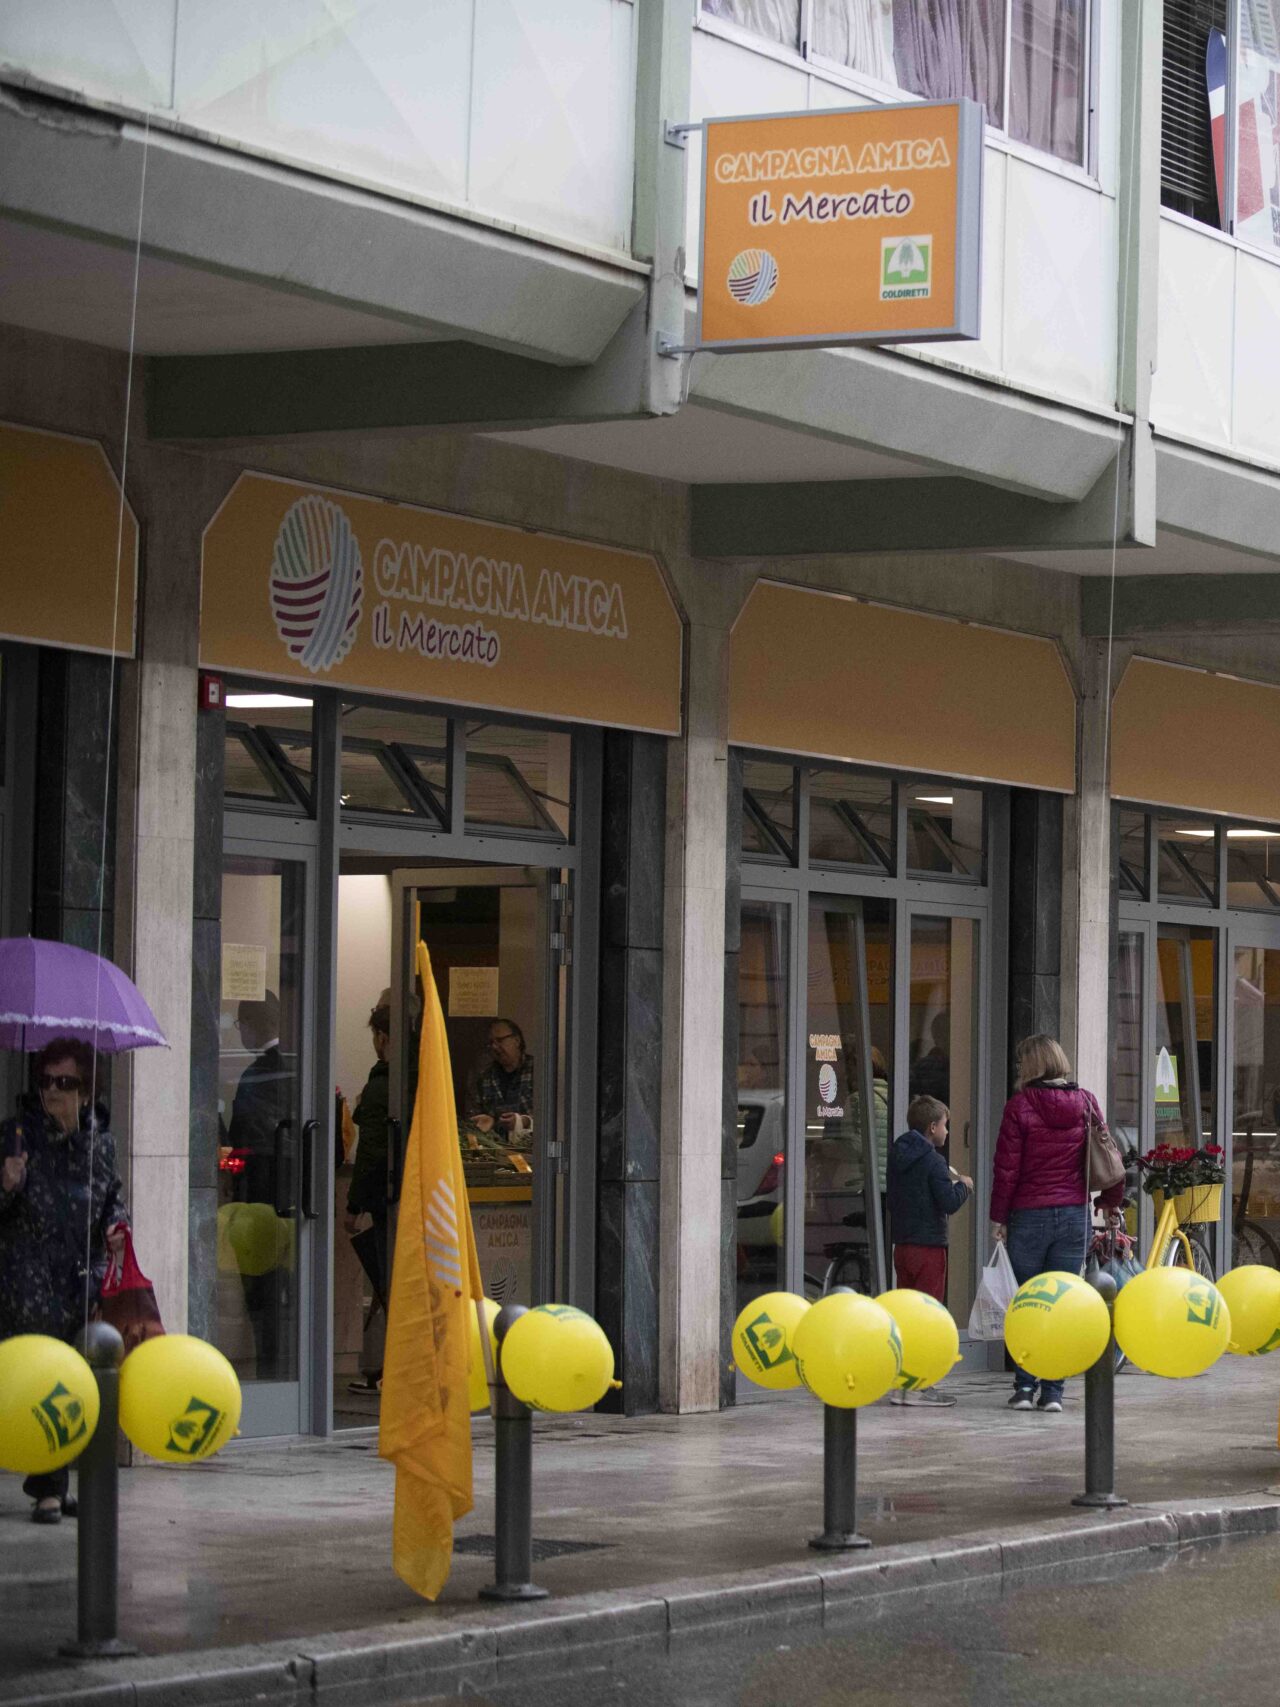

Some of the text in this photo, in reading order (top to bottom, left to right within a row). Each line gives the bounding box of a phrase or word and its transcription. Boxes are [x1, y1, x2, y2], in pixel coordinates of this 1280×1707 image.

[715, 138, 951, 183] CAMPAGNA AMICA
[751, 184, 912, 224] Il Mercato
[882, 287, 930, 299] COLDIRETTI
[374, 538, 628, 638] CAMPAGNA AMICA
[372, 604, 499, 667] Il Mercato
[480, 1214, 529, 1229] CAMPAGNA
[488, 1232, 519, 1247] AMICA
